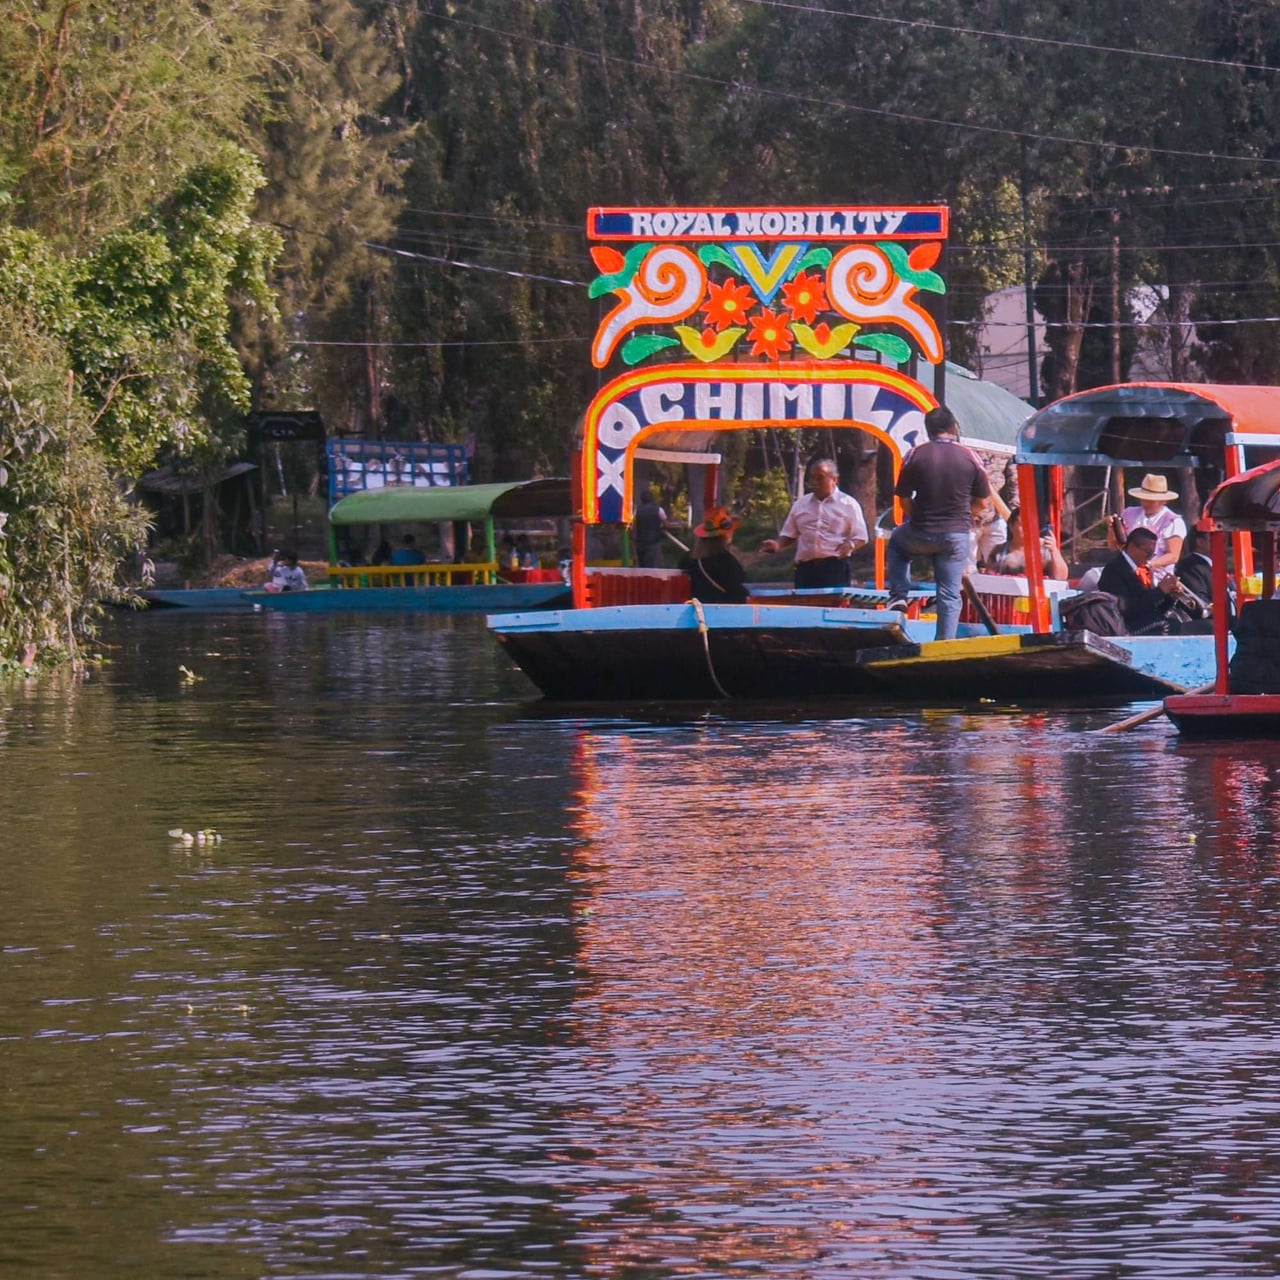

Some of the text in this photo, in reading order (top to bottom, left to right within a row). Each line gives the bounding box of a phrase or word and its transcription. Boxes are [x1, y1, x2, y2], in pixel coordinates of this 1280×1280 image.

[629, 210, 908, 236] ROYAL MOBILITY
[596, 381, 930, 499] XOCHIMILC
